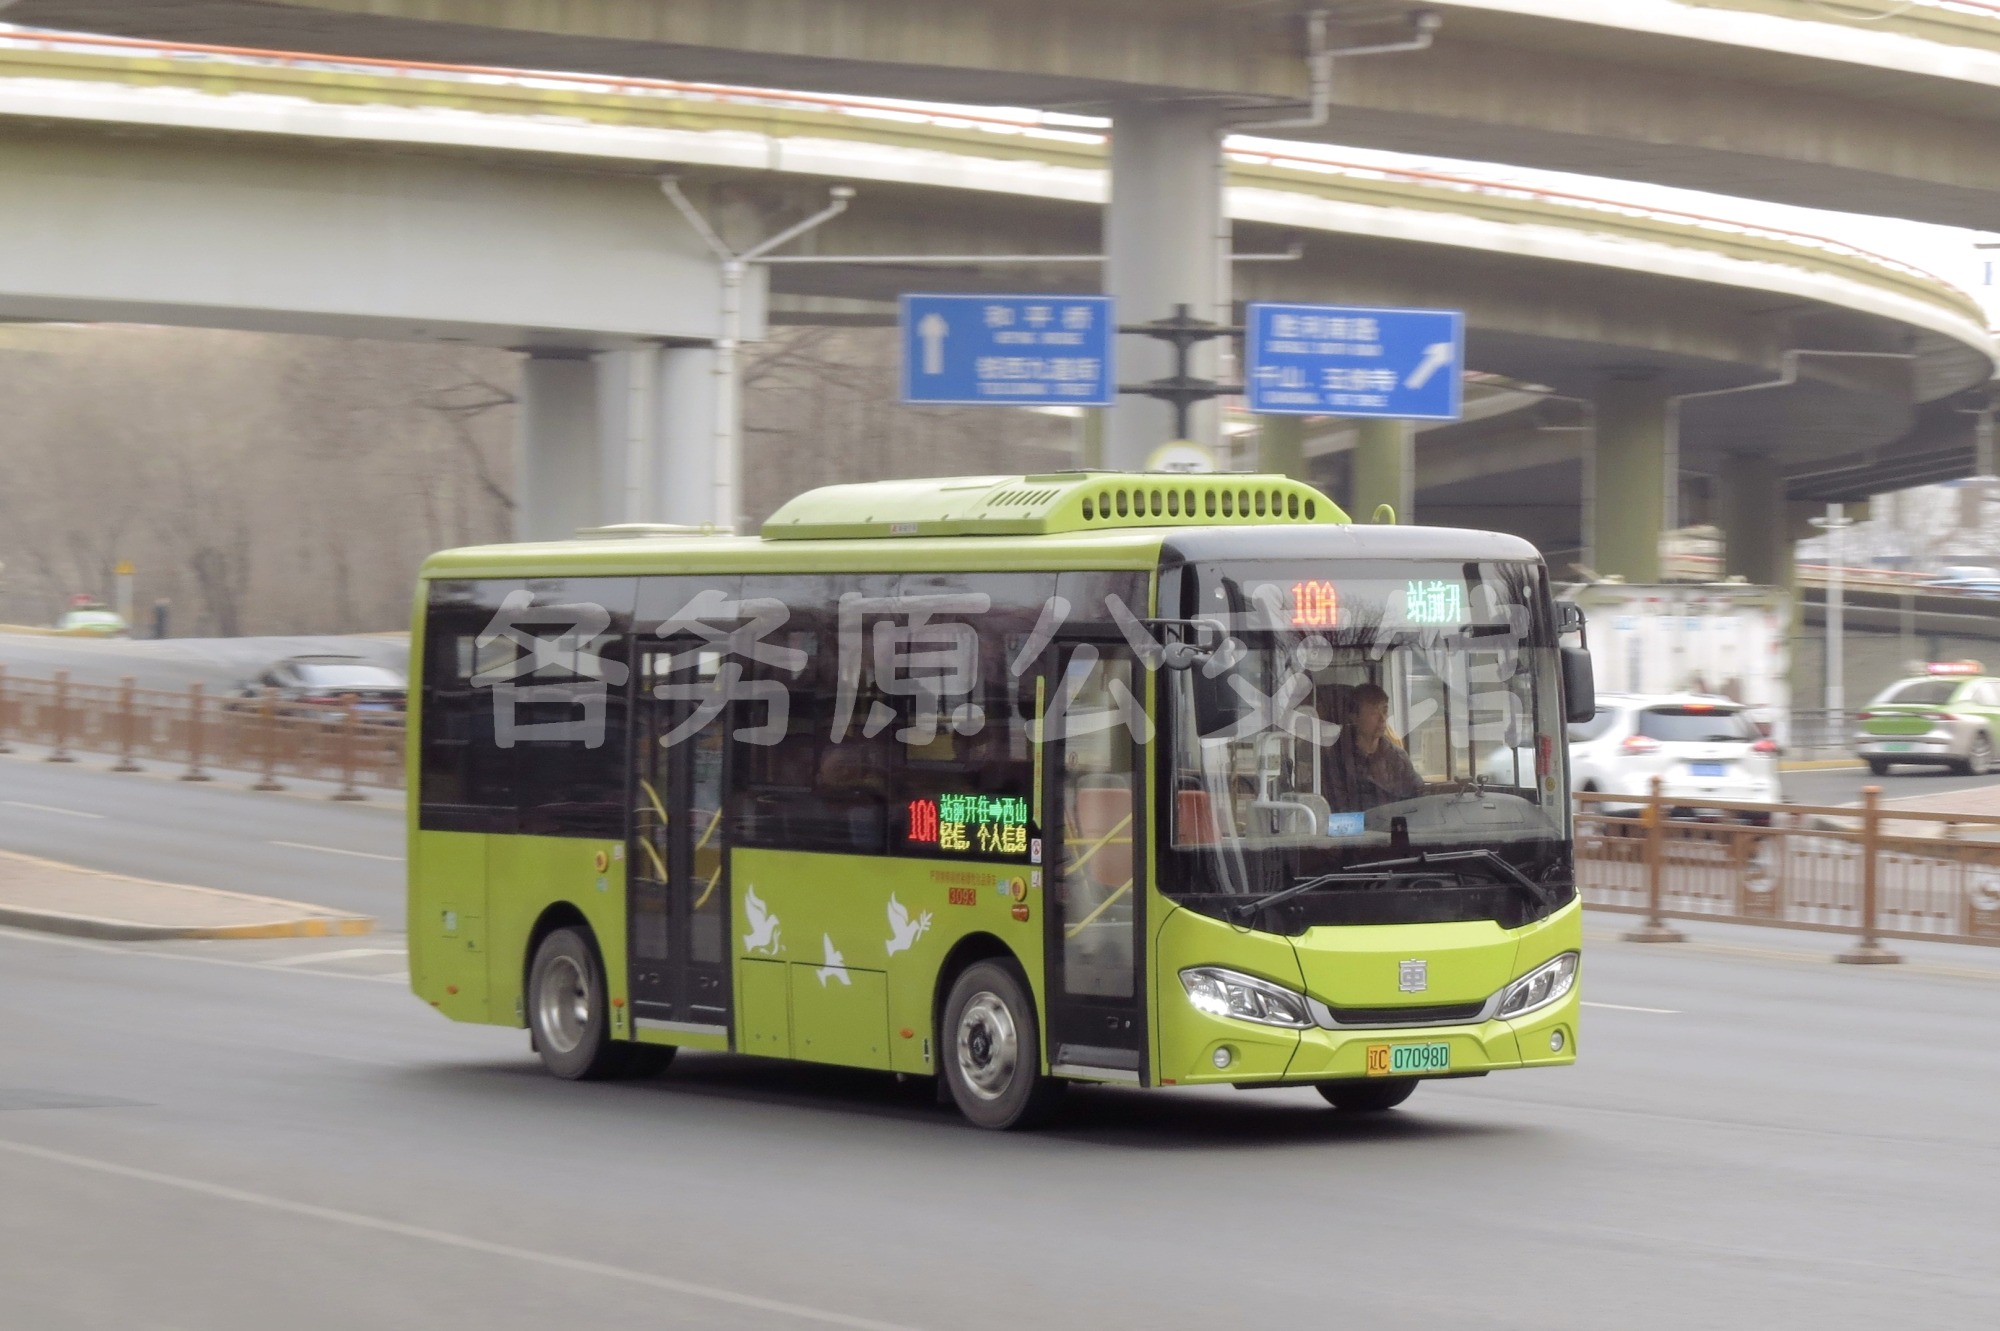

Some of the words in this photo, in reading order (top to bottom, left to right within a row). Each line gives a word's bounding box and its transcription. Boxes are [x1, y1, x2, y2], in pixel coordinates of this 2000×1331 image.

[1291, 580, 1339, 625] 10A
[908, 799, 937, 842] 10A
[949, 888, 976, 905] 3093
[1394, 1046, 1449, 1069] 07098D
